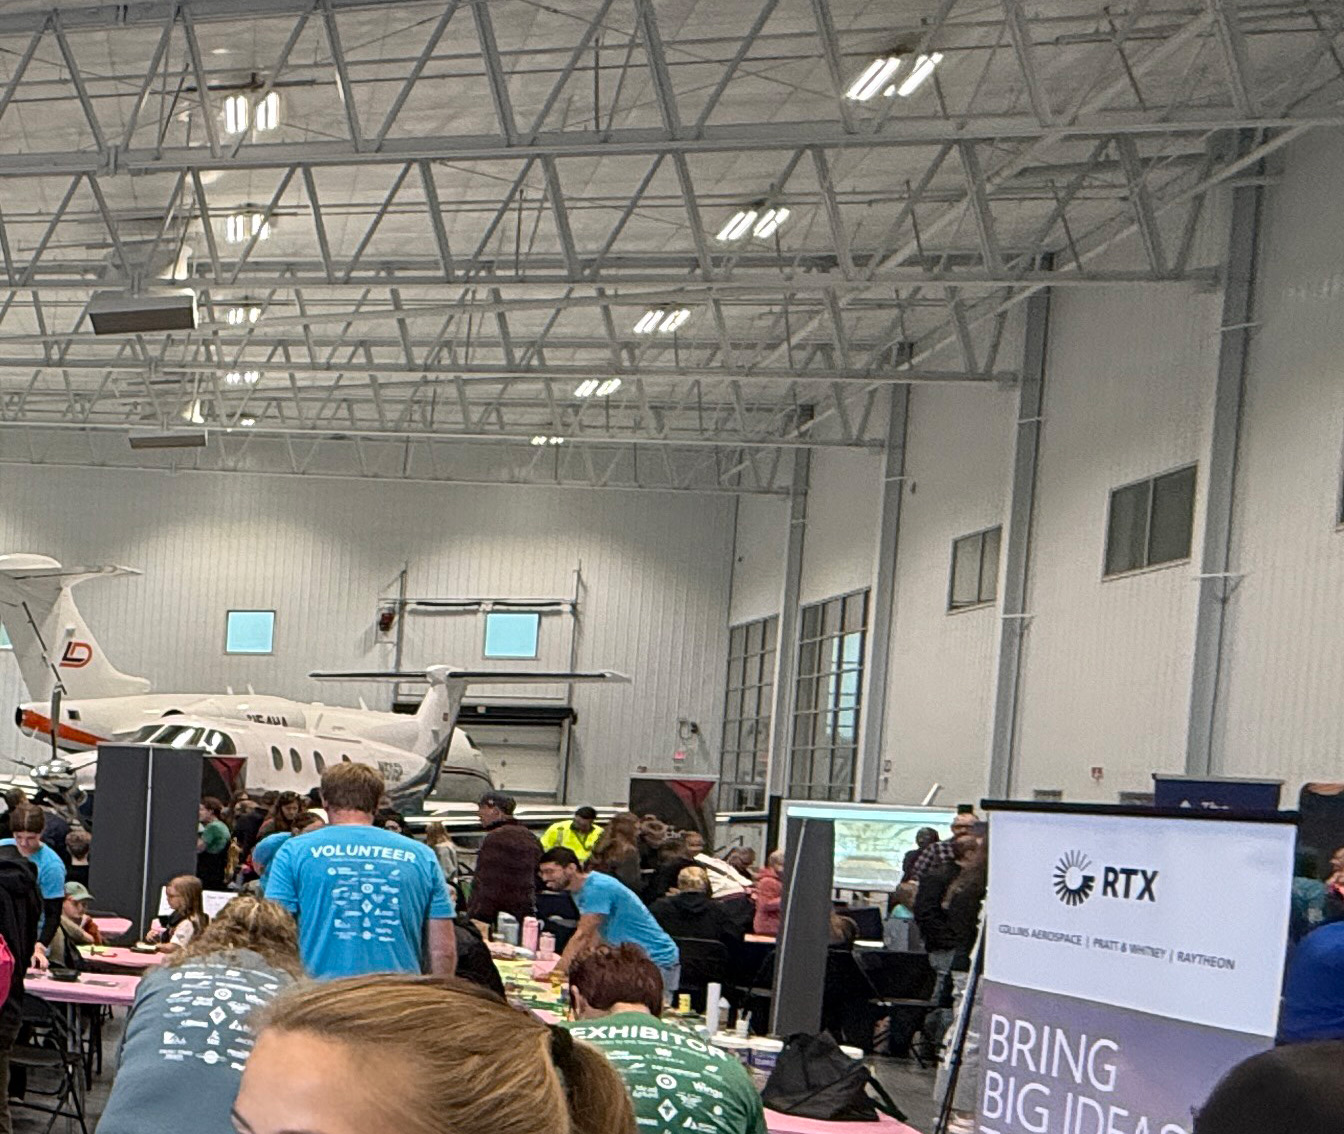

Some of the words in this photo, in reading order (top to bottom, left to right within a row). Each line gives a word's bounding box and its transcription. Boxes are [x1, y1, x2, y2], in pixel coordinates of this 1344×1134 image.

[310, 844, 416, 863] VOLUNTEER
[1102, 866, 1159, 902] RTX
[998, 924, 1030, 938] COLLINS
[1031, 928, 1082, 946] AEROSPACE
[1093, 938, 1119, 951] PRATT
[1129, 943, 1167, 959] WHITNEY
[1177, 951, 1236, 970] RAYTHEON
[569, 1025, 729, 1062] EXHIBITOR
[987, 1013, 1120, 1092] BRING
[982, 1070, 1051, 1133] BIG
